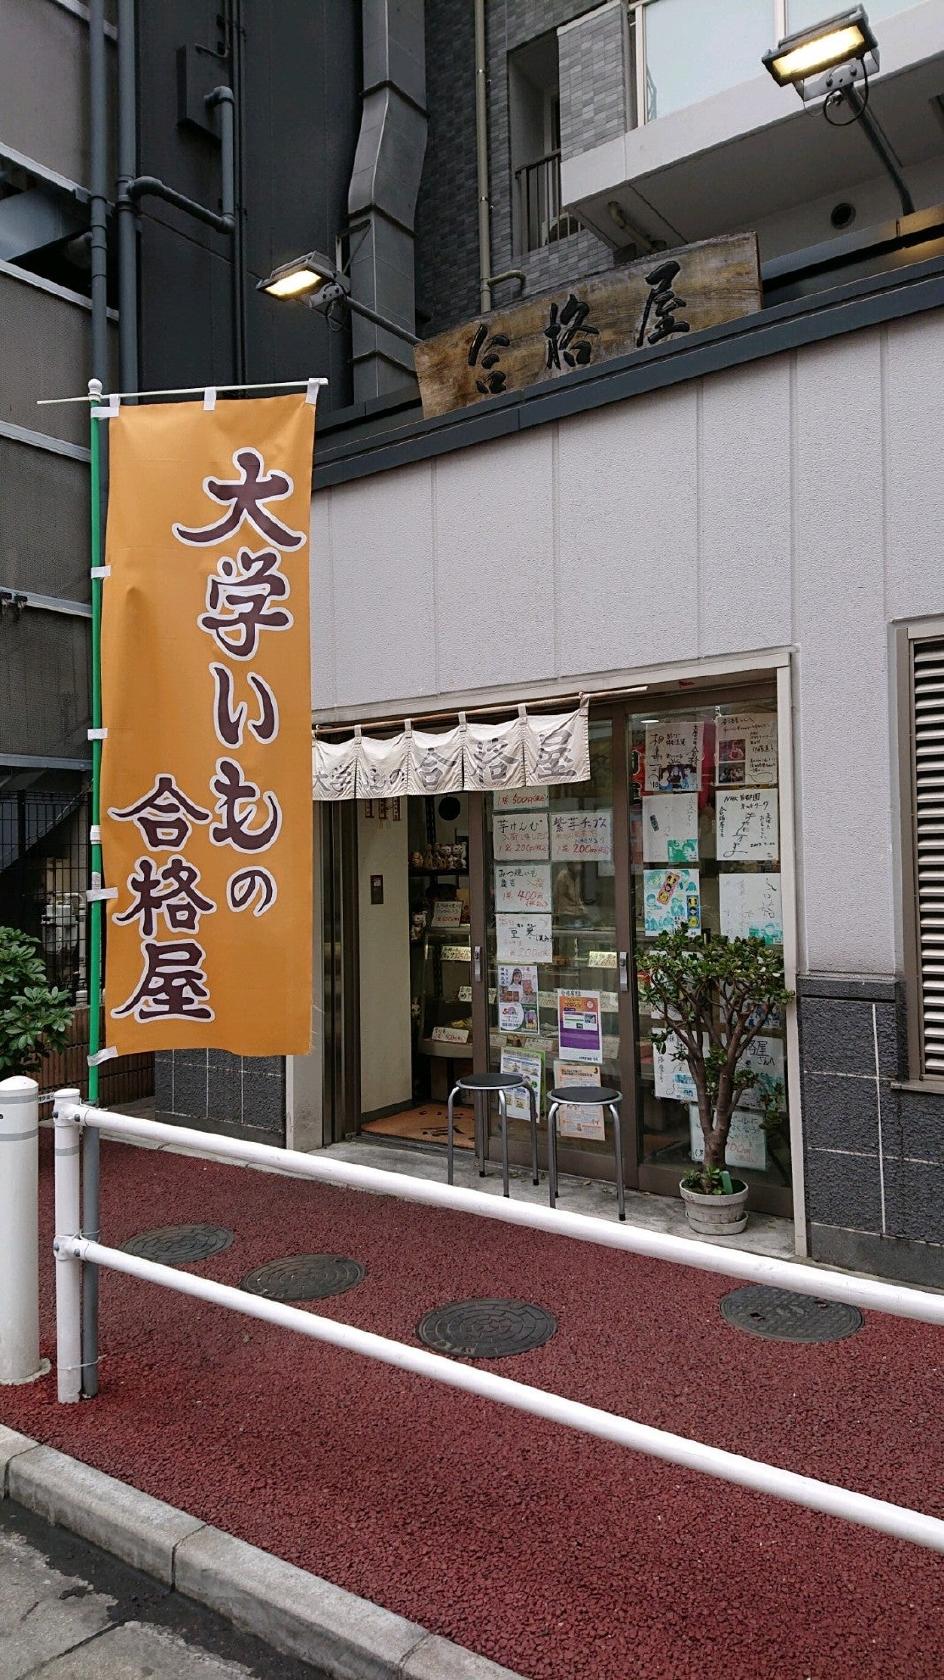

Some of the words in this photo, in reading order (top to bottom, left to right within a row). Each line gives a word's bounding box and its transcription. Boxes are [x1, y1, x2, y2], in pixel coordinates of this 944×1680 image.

[468, 260, 691, 395] 合格屋
[173, 448, 307, 916] 大学いもの
[108, 774, 217, 1023] 合格屋
